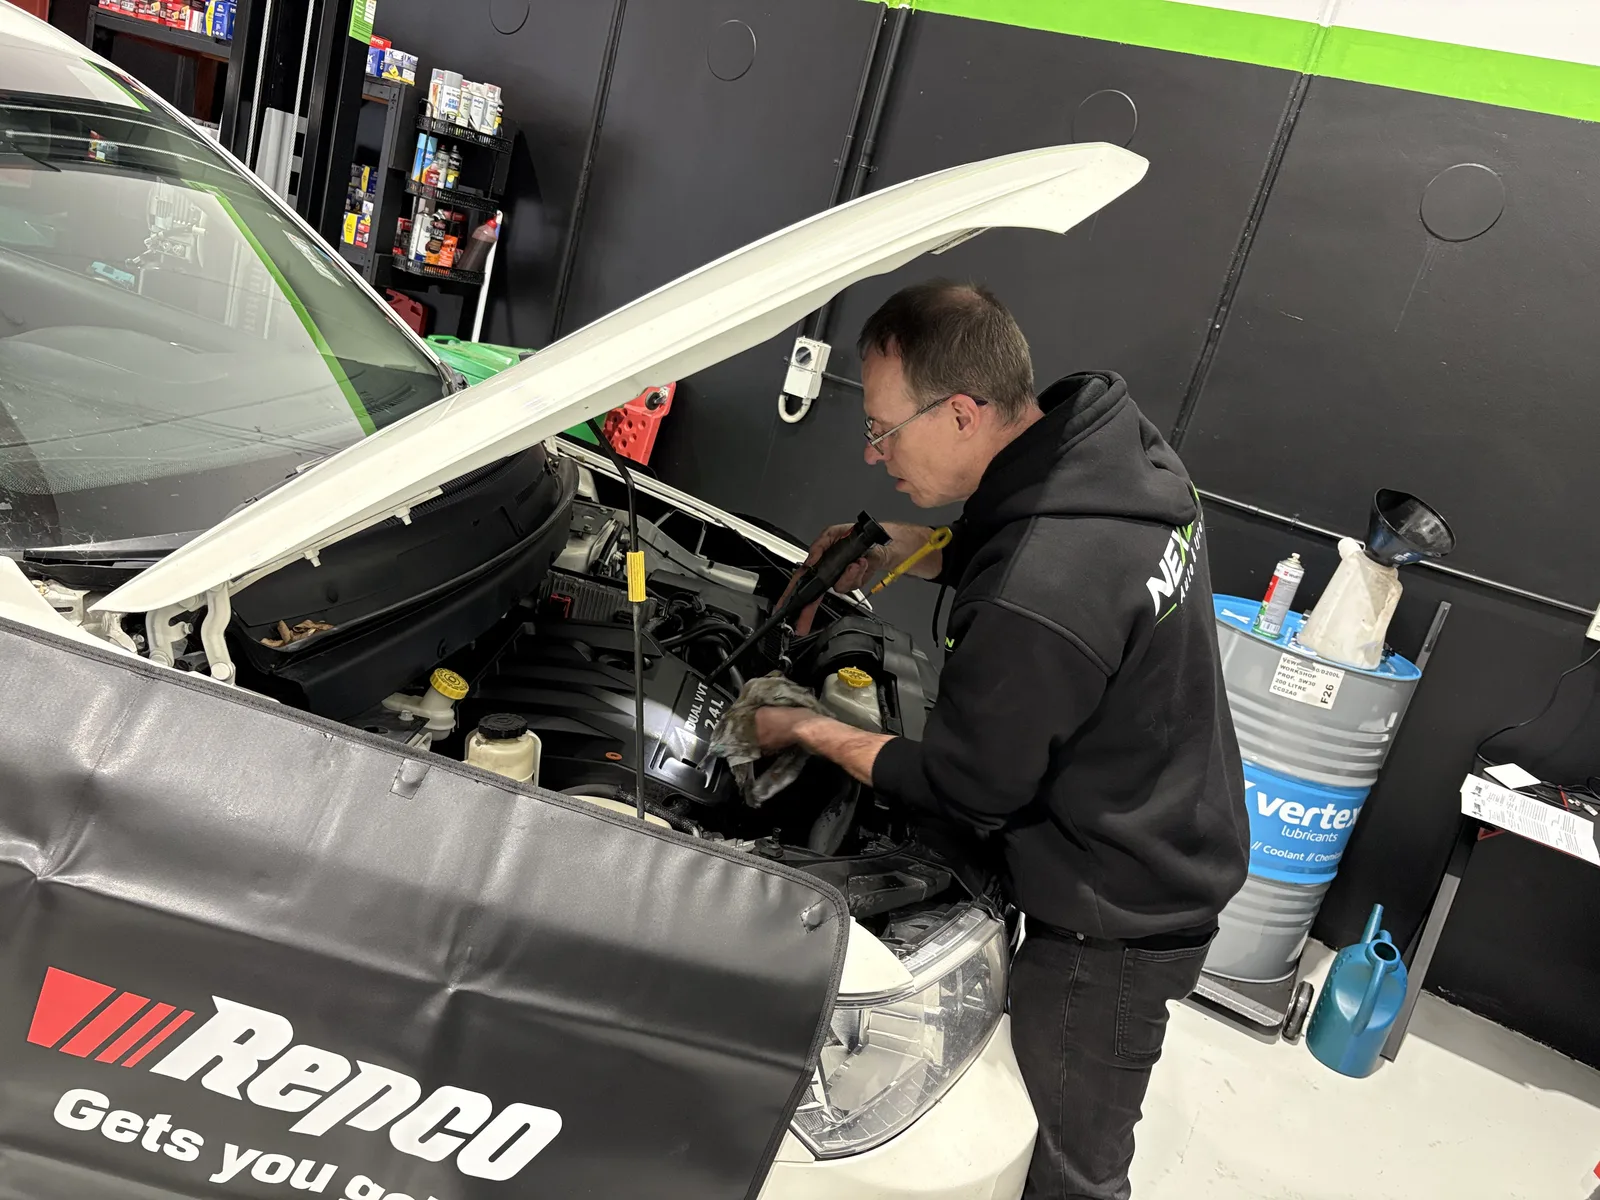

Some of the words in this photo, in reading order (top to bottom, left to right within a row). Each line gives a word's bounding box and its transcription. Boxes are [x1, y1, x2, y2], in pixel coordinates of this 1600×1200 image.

[1277, 671, 1295, 681] PROF.
[1298, 678, 1316, 687] 5W30
[1280, 664, 1317, 679] WORKSHOP
[1275, 677, 1286, 686] 200
[1287, 682, 1307, 692] LITRE
[1320, 684, 1334, 704] F26
[683, 704, 703, 732] DUAL
[694, 682, 708, 703] VVT
[1281, 825, 1338, 842] lubricants
[1263, 845, 1304, 861] Coolant
[150, 995, 563, 1182] Repco
[53, 1088, 205, 1163] Gets
[208, 1142, 339, 1194] you
